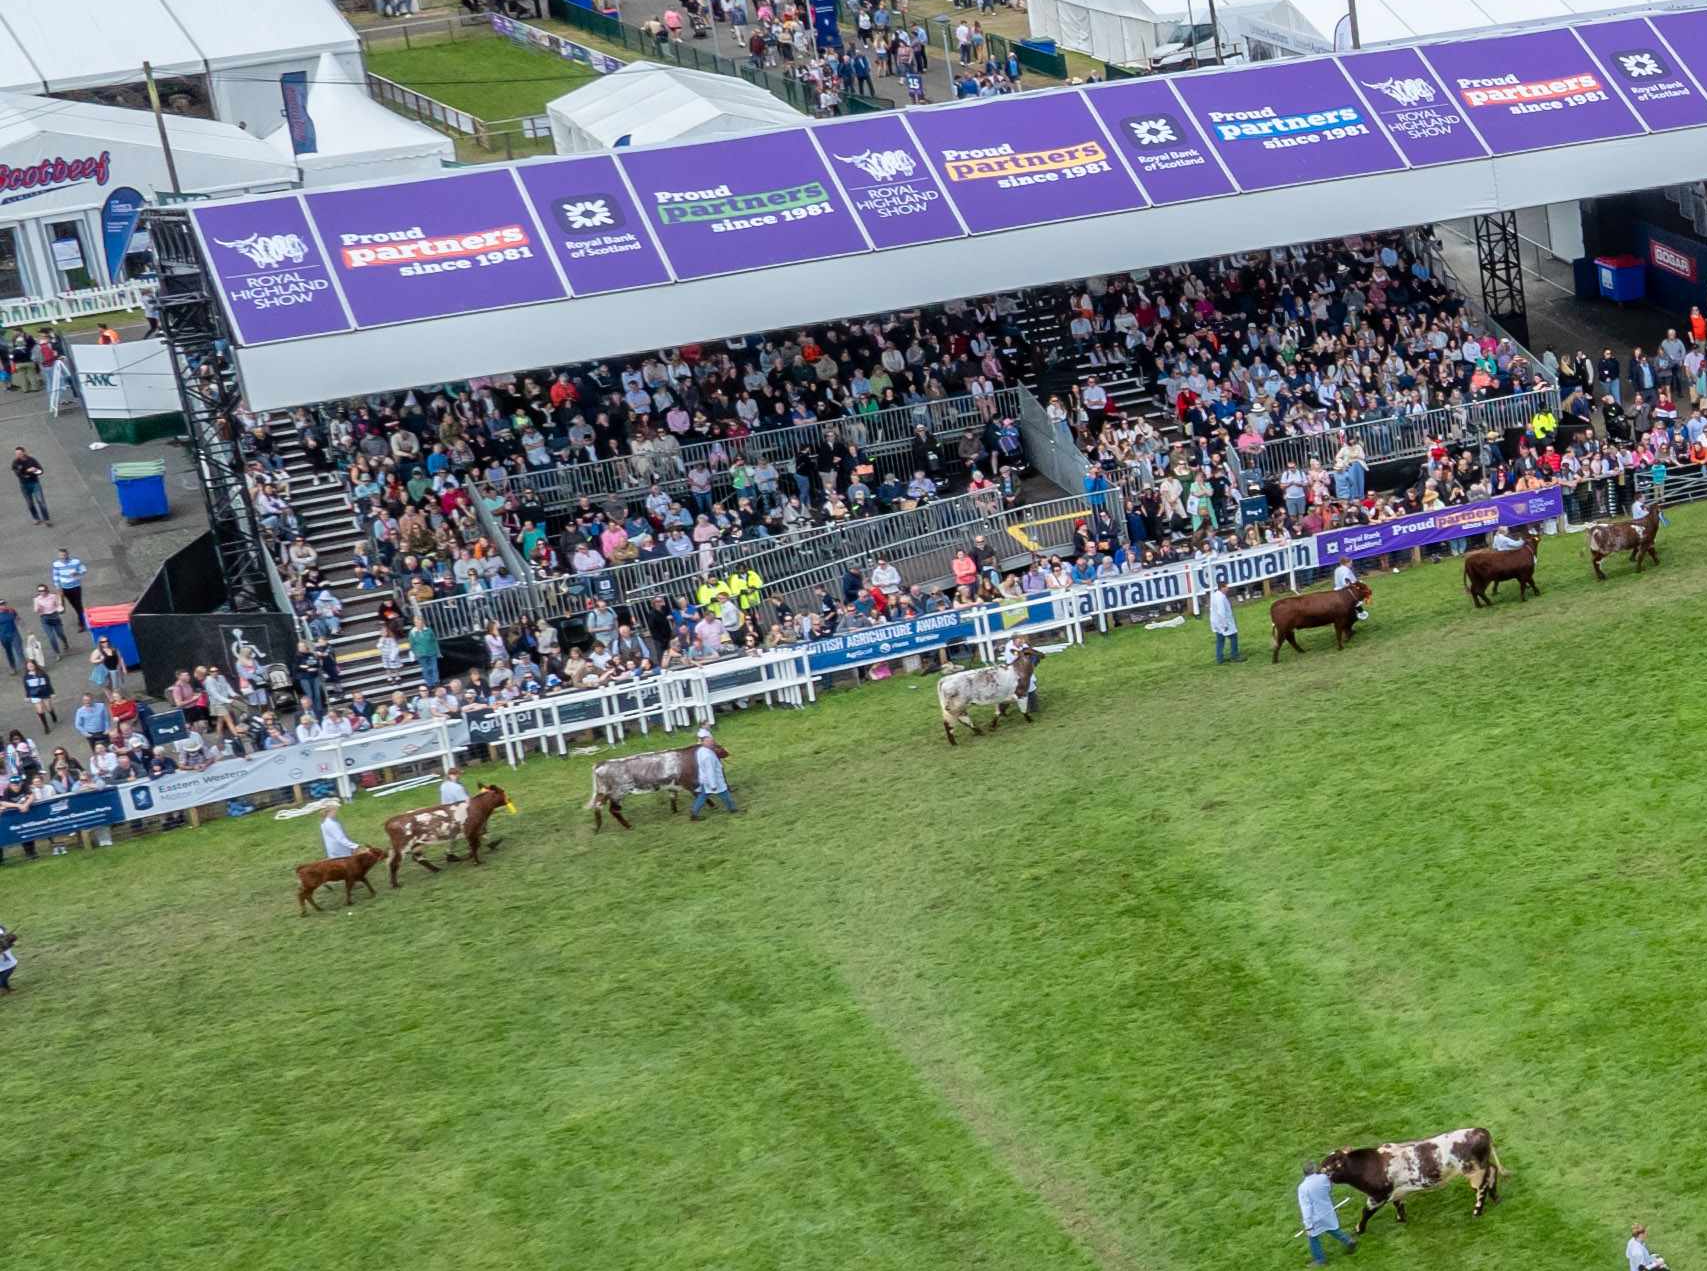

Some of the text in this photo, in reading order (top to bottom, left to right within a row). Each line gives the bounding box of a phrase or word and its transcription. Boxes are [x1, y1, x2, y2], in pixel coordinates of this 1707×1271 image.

[1457, 73, 1520, 90] Proud
[1467, 74, 1598, 106] partners
[1631, 80, 1685, 97] Royal Bank
[1511, 91, 1610, 116] since 1981
[1649, 87, 1690, 101] Scotland
[1208, 107, 1276, 123] Proud
[1218, 106, 1360, 141] partners
[1387, 115, 1460, 134] HIGHLAND
[1396, 108, 1438, 124] ROYAL
[1264, 123, 1370, 149] since 1981
[1408, 125, 1453, 140] SHOW
[943, 144, 1014, 161] Proud
[951, 143, 1102, 180] partners
[1137, 148, 1199, 166] Royal Bank
[1158, 155, 1204, 170] Scotland
[998, 161, 1112, 189] since 1981
[655, 185, 732, 203] Proud
[857, 190, 938, 210] HIGHLAND
[869, 185, 916, 200] ROYAL
[663, 184, 828, 223] partners
[879, 202, 929, 218] SHOW
[712, 203, 834, 233] since 1981
[342, 228, 423, 245] Proud
[566, 232, 636, 250] Royal Bank
[347, 226, 524, 268] partners
[585, 241, 642, 256] Scotland
[401, 247, 533, 277] since 1981
[247, 273, 304, 288] ROYAL
[232, 280, 328, 301] HIGHLAND
[255, 293, 313, 310] SHOW
[1392, 508, 1498, 536] Proud partners
[1198, 543, 1310, 588] Galbraih
[847, 614, 957, 651] AGRICULTURE AWARDS
[470, 710, 531, 733] Agricot
[158, 769, 248, 795] Eastern Western
